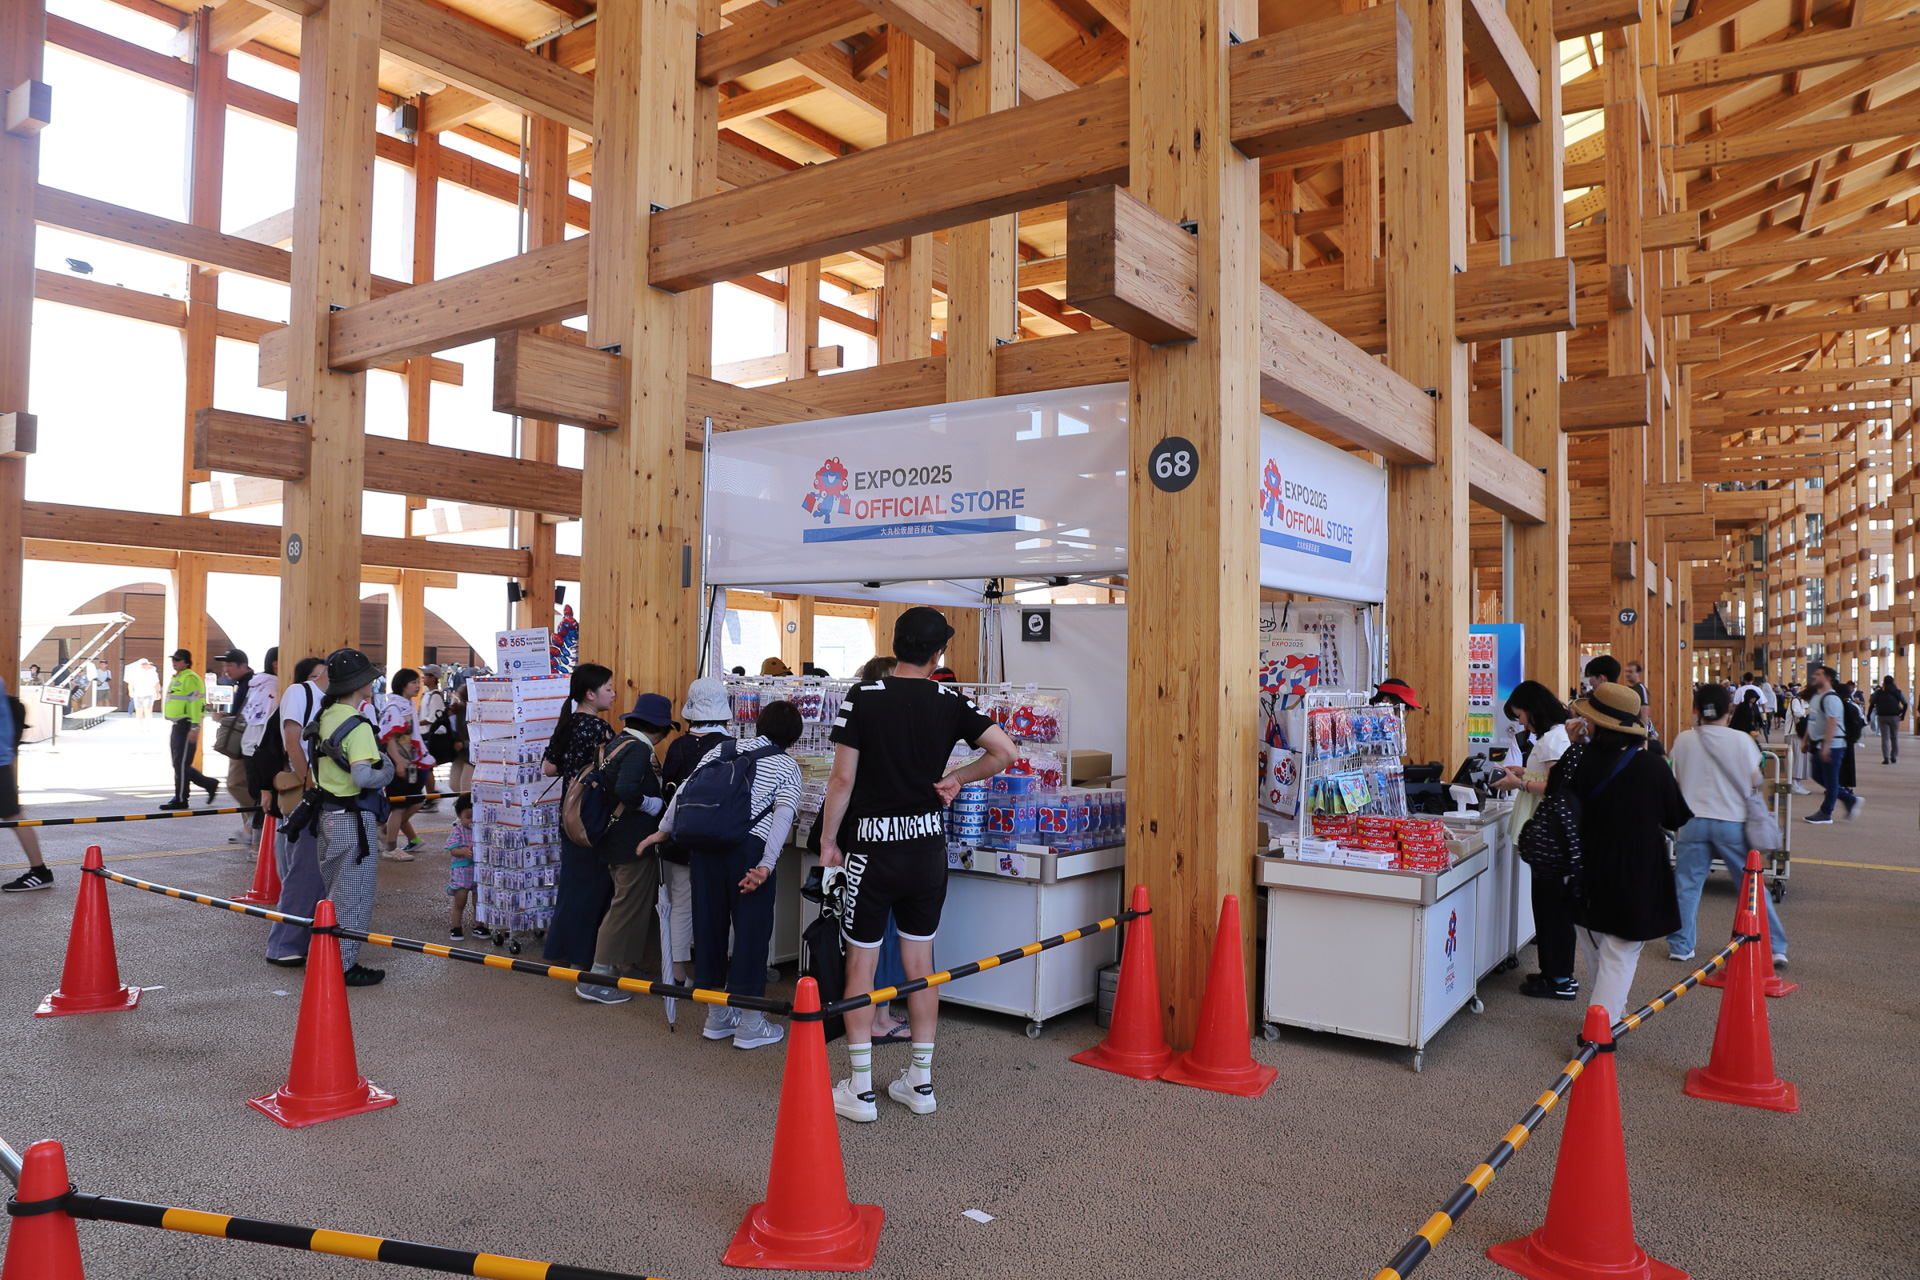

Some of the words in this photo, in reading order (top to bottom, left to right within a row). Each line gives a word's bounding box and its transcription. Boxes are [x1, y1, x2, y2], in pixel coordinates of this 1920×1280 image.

[1155, 450, 1191, 479] 68
[854, 465, 952, 490] EXPO2025
[1284, 480, 1328, 510] EXPO2025
[854, 495, 947, 520] OFFICIAL
[950, 488, 1026, 514] STORE
[880, 524, 935, 536] 大丸松坂屋百貨店
[1285, 509, 1326, 537] OFFICIAL
[1326, 520, 1353, 545] STORE
[288, 541, 300, 557] 68
[1620, 612, 1635, 622] 67
[510, 637, 526, 647] 365
[517, 706, 523, 714] 2
[519, 727, 525, 735] 3
[523, 789, 529, 797] 6
[858, 817, 884, 841] LOS
[525, 851, 531, 859] 9
[844, 852, 868, 930] YDROGEN
